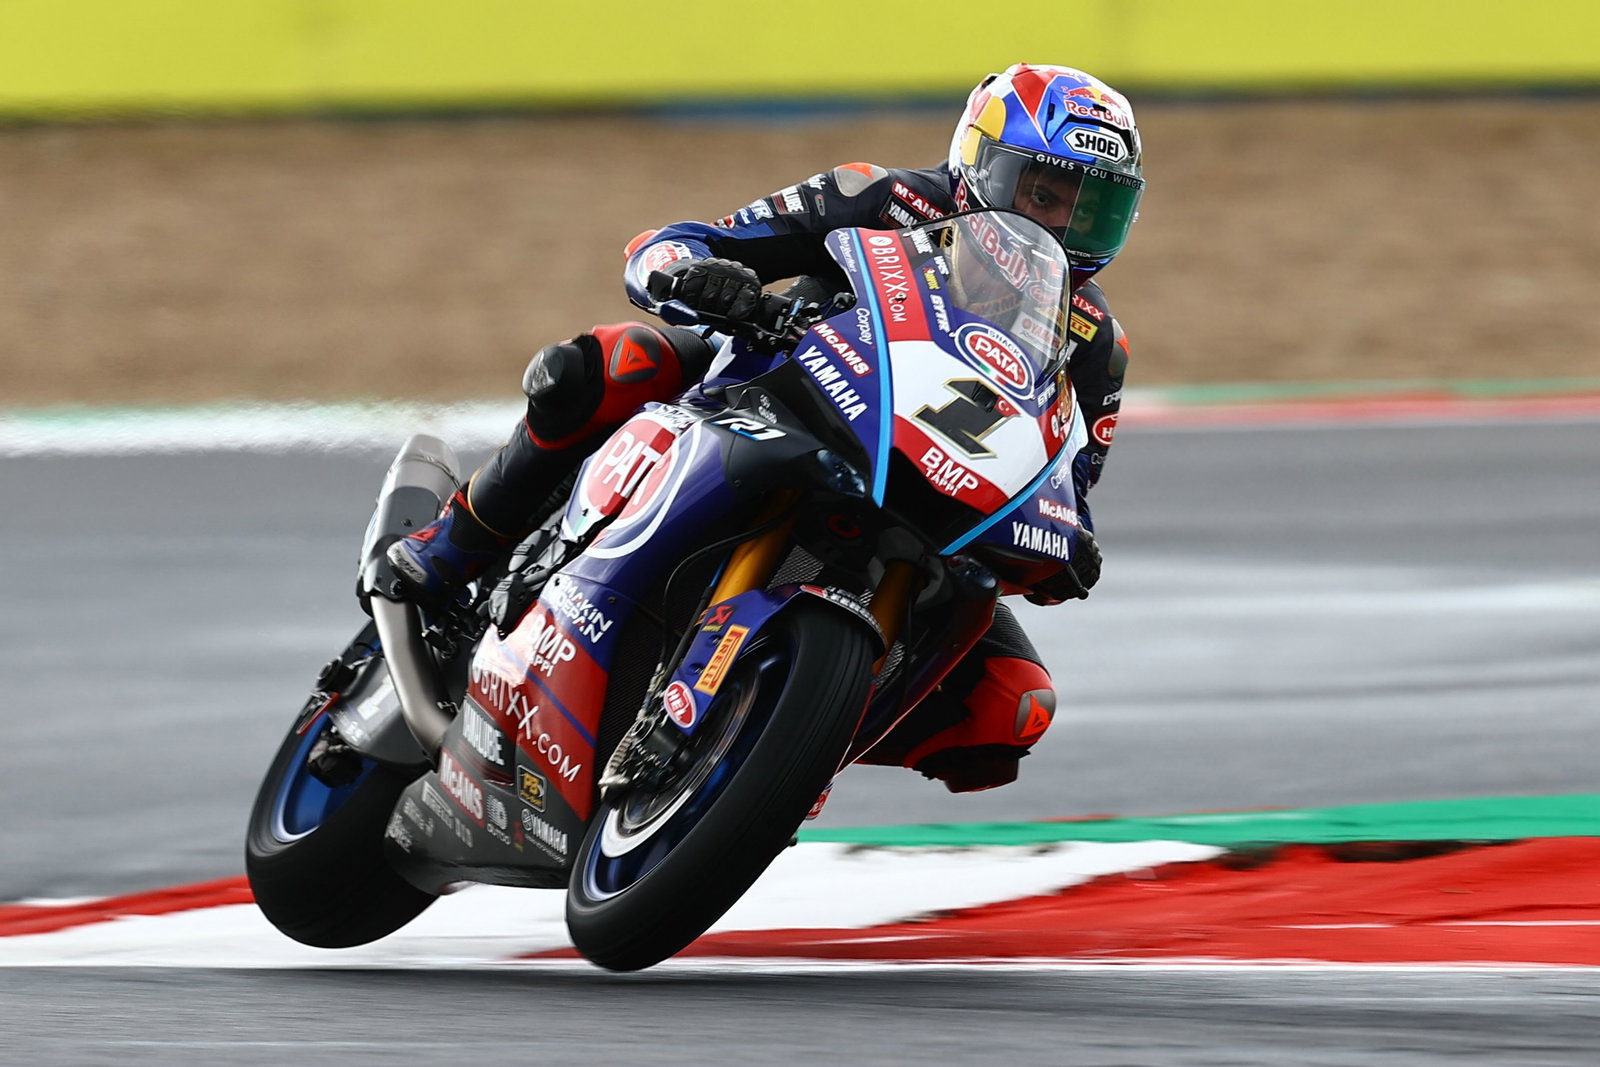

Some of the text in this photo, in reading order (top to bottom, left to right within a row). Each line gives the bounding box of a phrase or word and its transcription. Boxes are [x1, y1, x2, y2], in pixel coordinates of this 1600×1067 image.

[1064, 100, 1130, 128] Red Bull
[1074, 132, 1119, 158] SHOEI
[1036, 153, 1142, 190] GIVES YOU WINGS
[980, 223, 1026, 281] Bull
[856, 307, 873, 345] Corpay
[1072, 293, 1104, 321] RIXX
[813, 323, 870, 375] McAMS
[975, 336, 1020, 382] PATA
[798, 344, 868, 422] YAMAHA
[710, 417, 788, 441] R1
[910, 377, 1020, 460] 1
[920, 446, 979, 491] BMP
[926, 467, 959, 497] TAPPI
[1038, 498, 1078, 526] McAMS
[1012, 521, 1069, 561] YAMAHA
